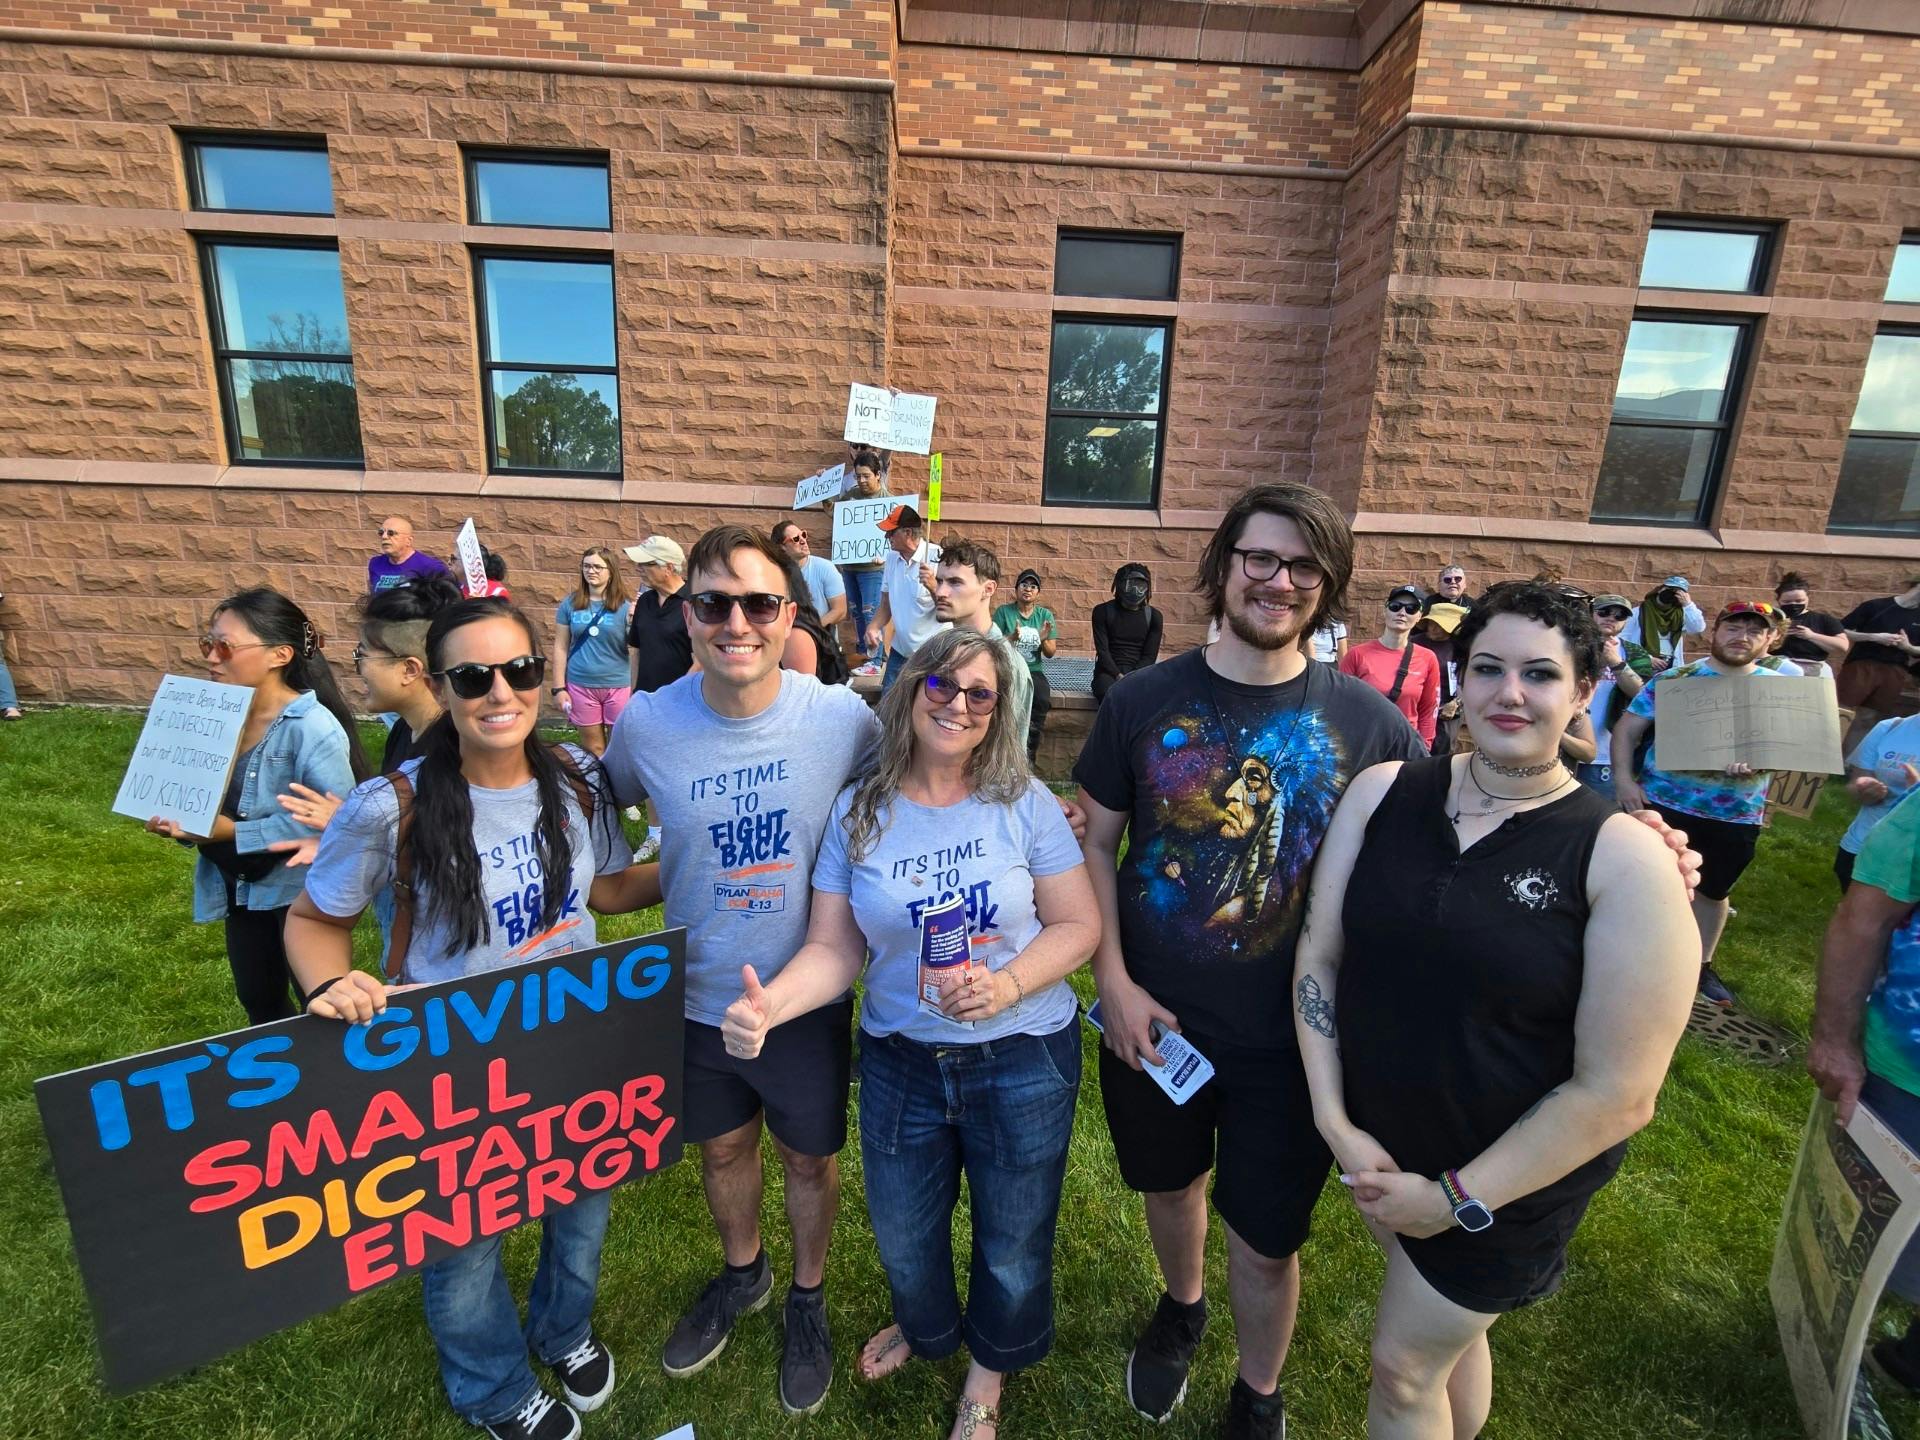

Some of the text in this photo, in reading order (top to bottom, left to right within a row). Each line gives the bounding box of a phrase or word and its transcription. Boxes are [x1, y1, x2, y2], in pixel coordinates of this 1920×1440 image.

[855, 388, 887, 405] LOOK
[854, 403, 931, 429] NOT STORMING
[857, 420, 894, 443] FEDERAL
[894, 429, 930, 447] BUILDING
[833, 538, 890, 561] DEMOCRA
[160, 682, 244, 714] Imagine Being Scared
[153, 709, 227, 740] of DIVERSITY
[141, 744, 229, 772] but not DICTATORSHIP
[126, 772, 211, 816] NO KINGS!
[691, 759, 789, 801] IT'S TIME
[730, 792, 759, 816] TO
[708, 808, 789, 849] FIGHT
[720, 830, 791, 869] BACK
[892, 838, 987, 880] IT'S TIME
[512, 857, 541, 884] TO
[932, 868, 960, 892] TO
[716, 887, 750, 898] DYLAN
[505, 889, 579, 948] BAK
[90, 945, 673, 1150] IT'S GIVING
[183, 1057, 531, 1213] SMALL
[238, 1074, 666, 1270] DICTATOR
[343, 1117, 675, 1292] ENERGY
